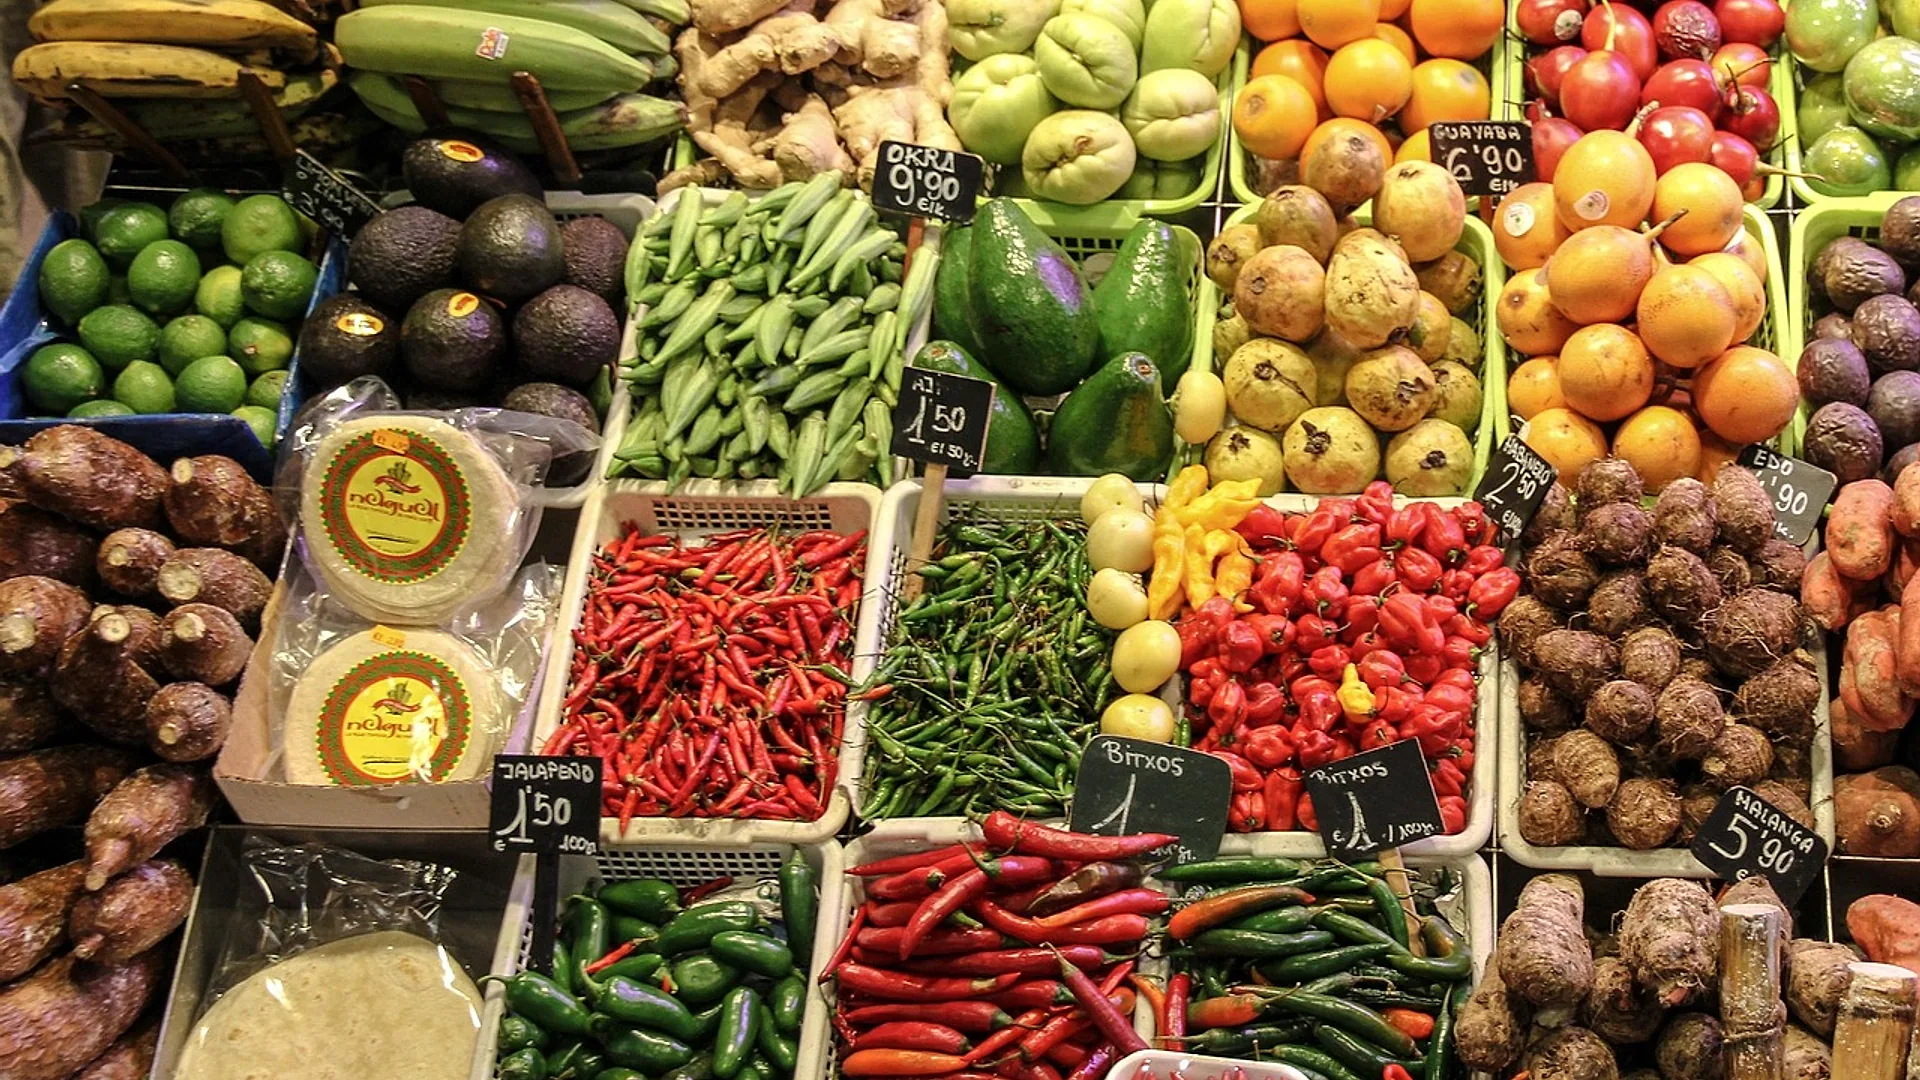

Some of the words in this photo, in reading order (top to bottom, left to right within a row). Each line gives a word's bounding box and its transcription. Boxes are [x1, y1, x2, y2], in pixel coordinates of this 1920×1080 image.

[1434, 125, 1521, 140] GUAYABA
[887, 144, 955, 173] OKRA
[1446, 144, 1523, 181] 6'90
[889, 164, 960, 206] 9'90
[903, 395, 966, 444] 1'50
[350, 489, 440, 522] nagual
[1755, 470, 1809, 515] '90
[346, 714, 440, 738] nagul
[498, 761, 594, 783] JALAPEÑO
[496, 785, 572, 843] 1'50
[1735, 790, 1815, 854] MALANGA
[1708, 813, 1795, 874] 5'90
